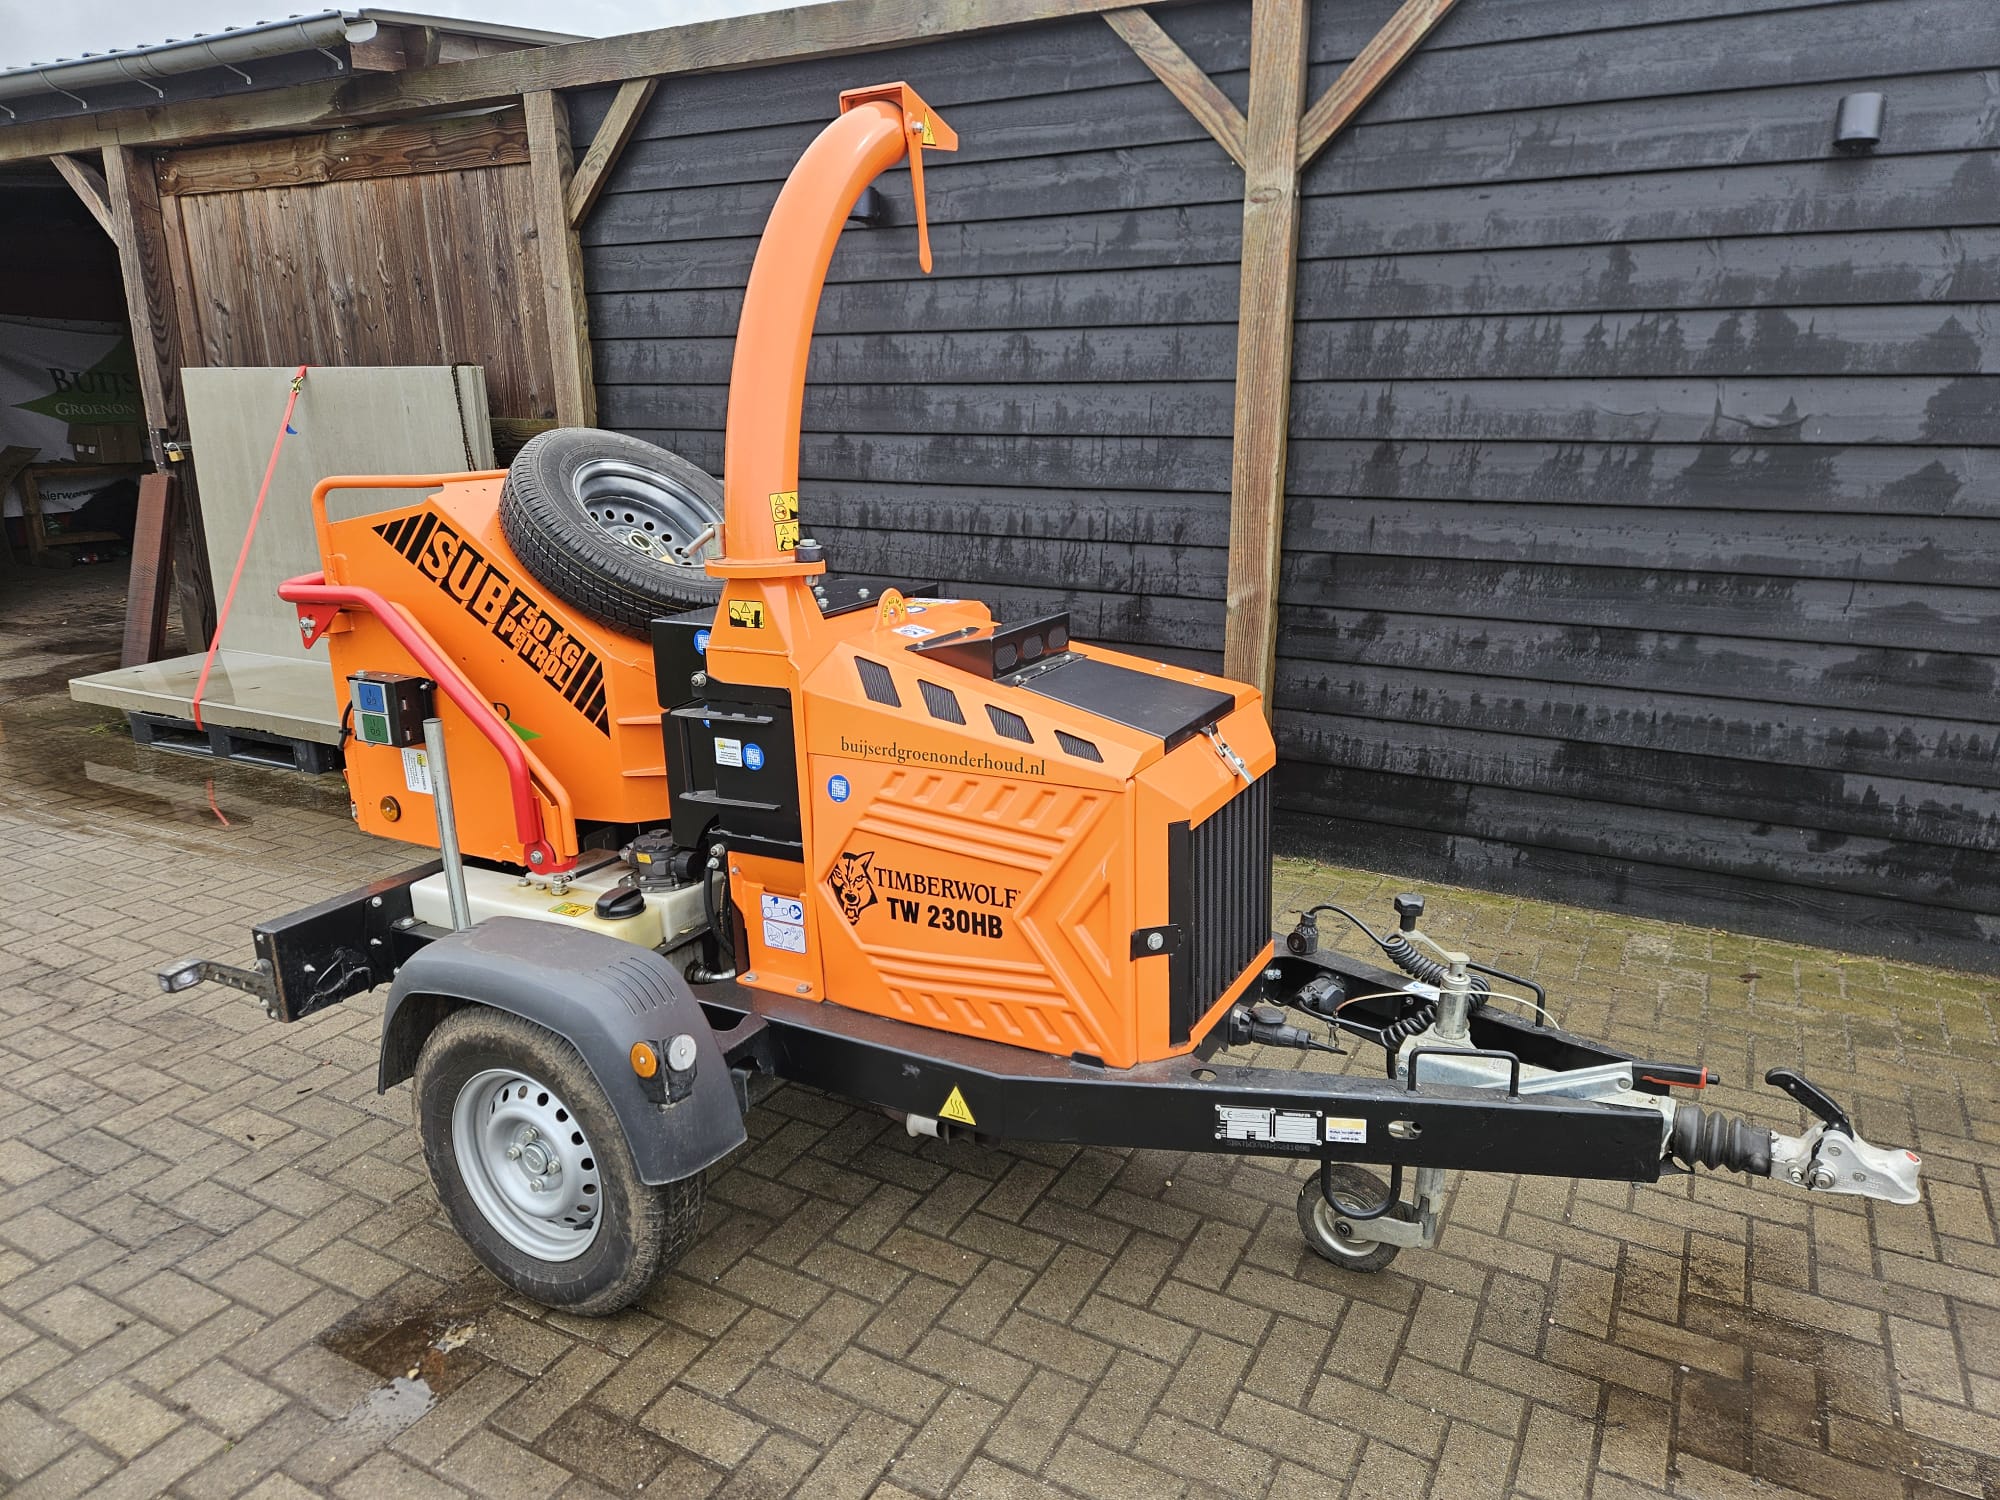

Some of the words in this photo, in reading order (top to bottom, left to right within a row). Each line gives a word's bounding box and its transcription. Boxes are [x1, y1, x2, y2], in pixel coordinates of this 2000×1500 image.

[421, 529, 511, 626] SUB
[498, 614, 572, 687] PETROL
[508, 595, 551, 642] 750
[548, 631, 584, 669] KG
[840, 736, 1046, 776] buijserdgroenonderhoud.nl
[873, 866, 1018, 909] TIMBERWOLF
[886, 896, 923, 924] TW
[927, 903, 1003, 940] 230HB
